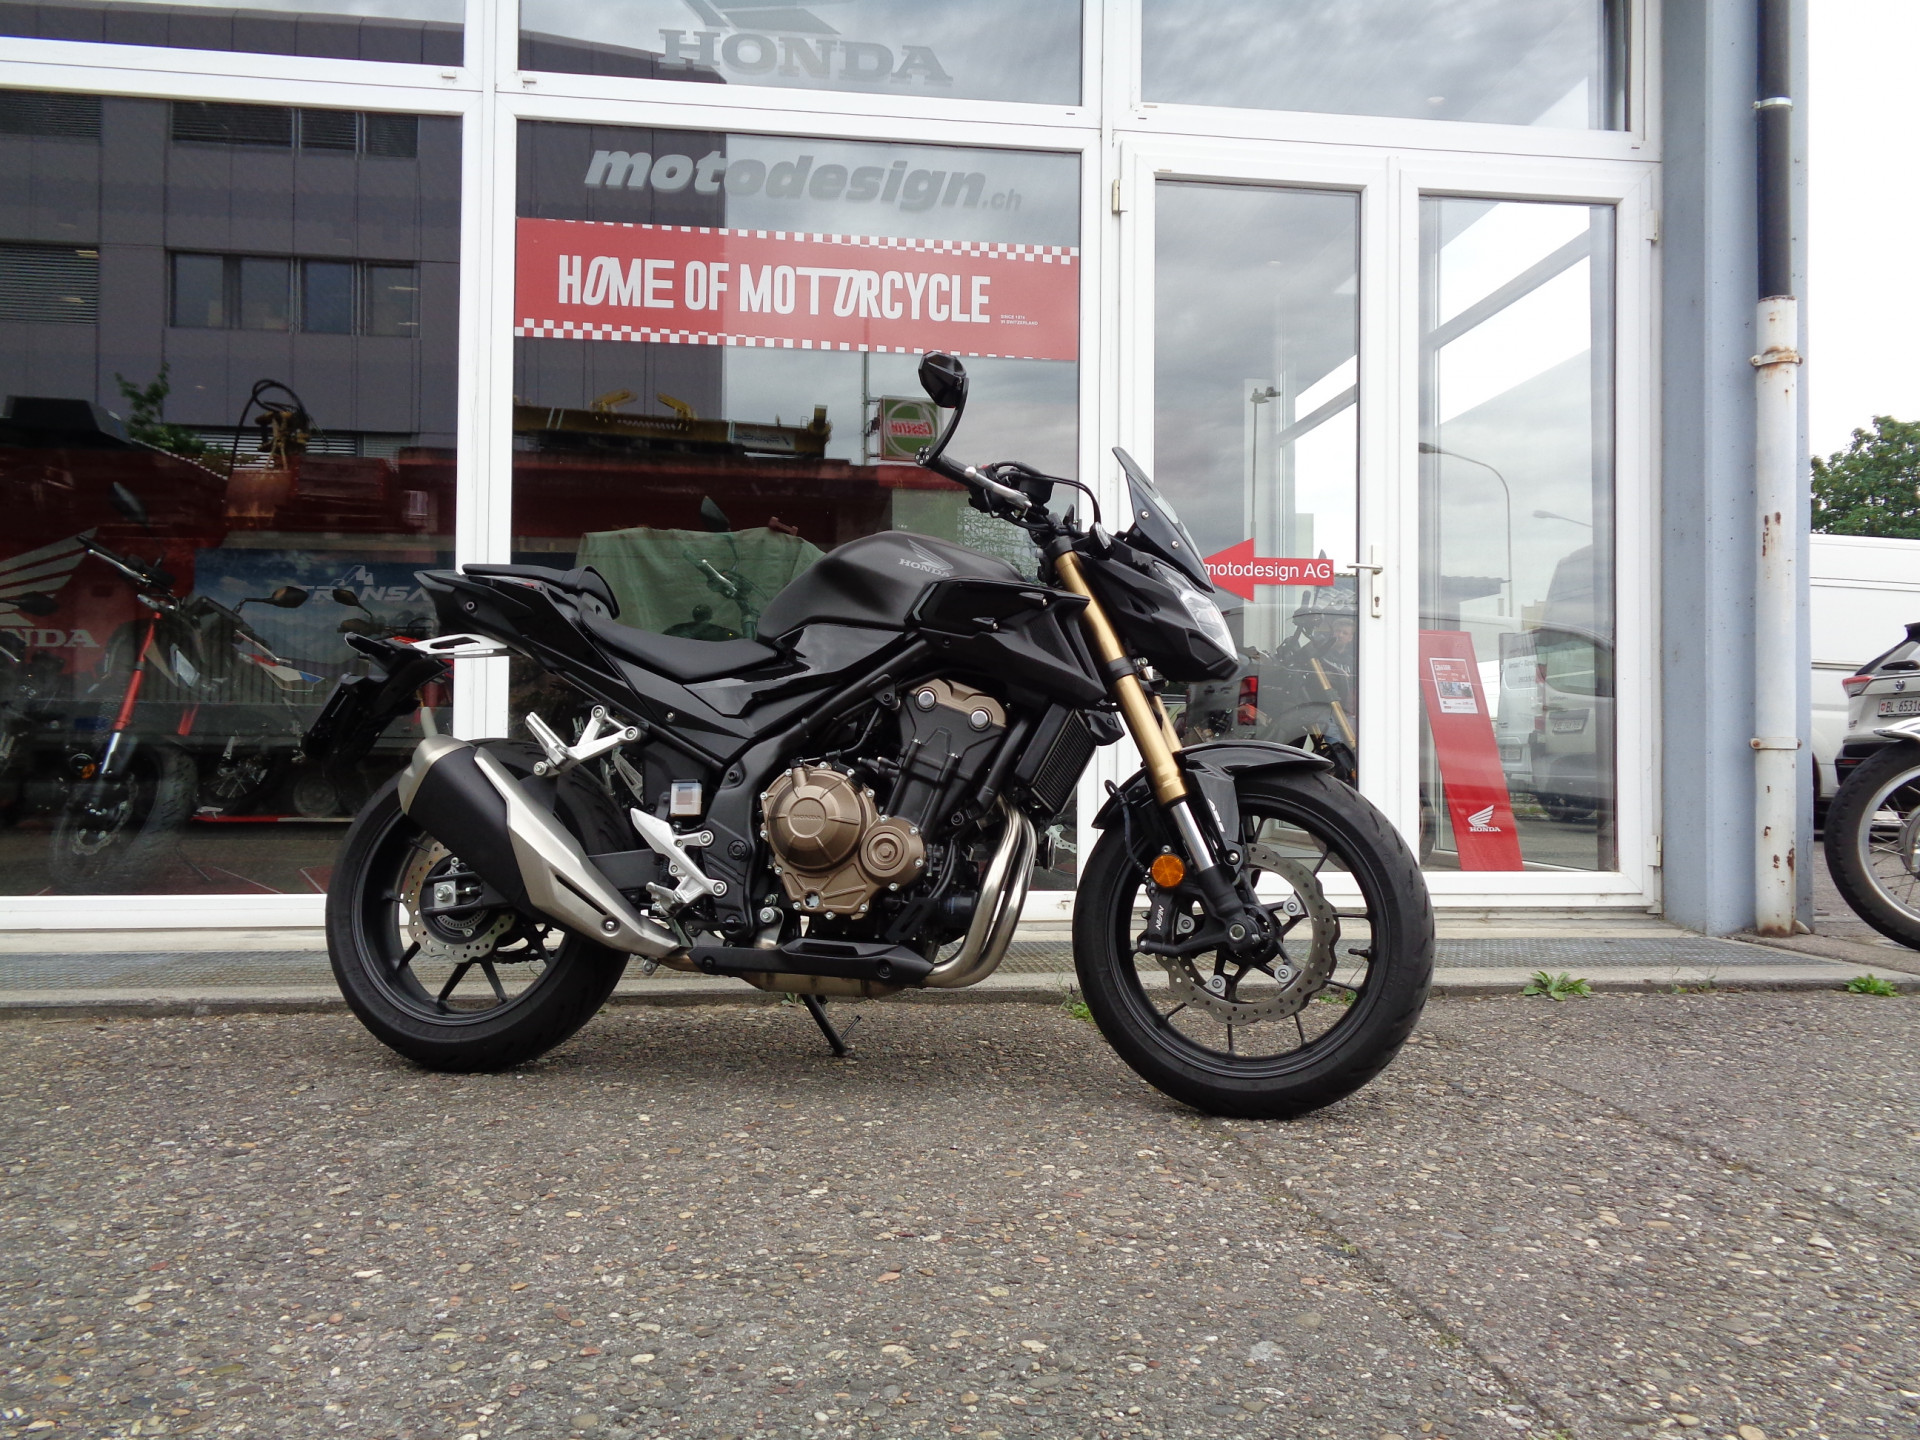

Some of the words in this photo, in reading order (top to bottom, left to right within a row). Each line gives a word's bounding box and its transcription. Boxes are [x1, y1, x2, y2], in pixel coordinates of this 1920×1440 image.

[657, 28, 953, 85] HONDA
[558, 254, 675, 309] HOME
[684, 260, 730, 311] OF
[739, 263, 991, 323] MOTORCYCLE
[898, 558, 950, 578] HONDA
[1303, 563, 1331, 579] AG
